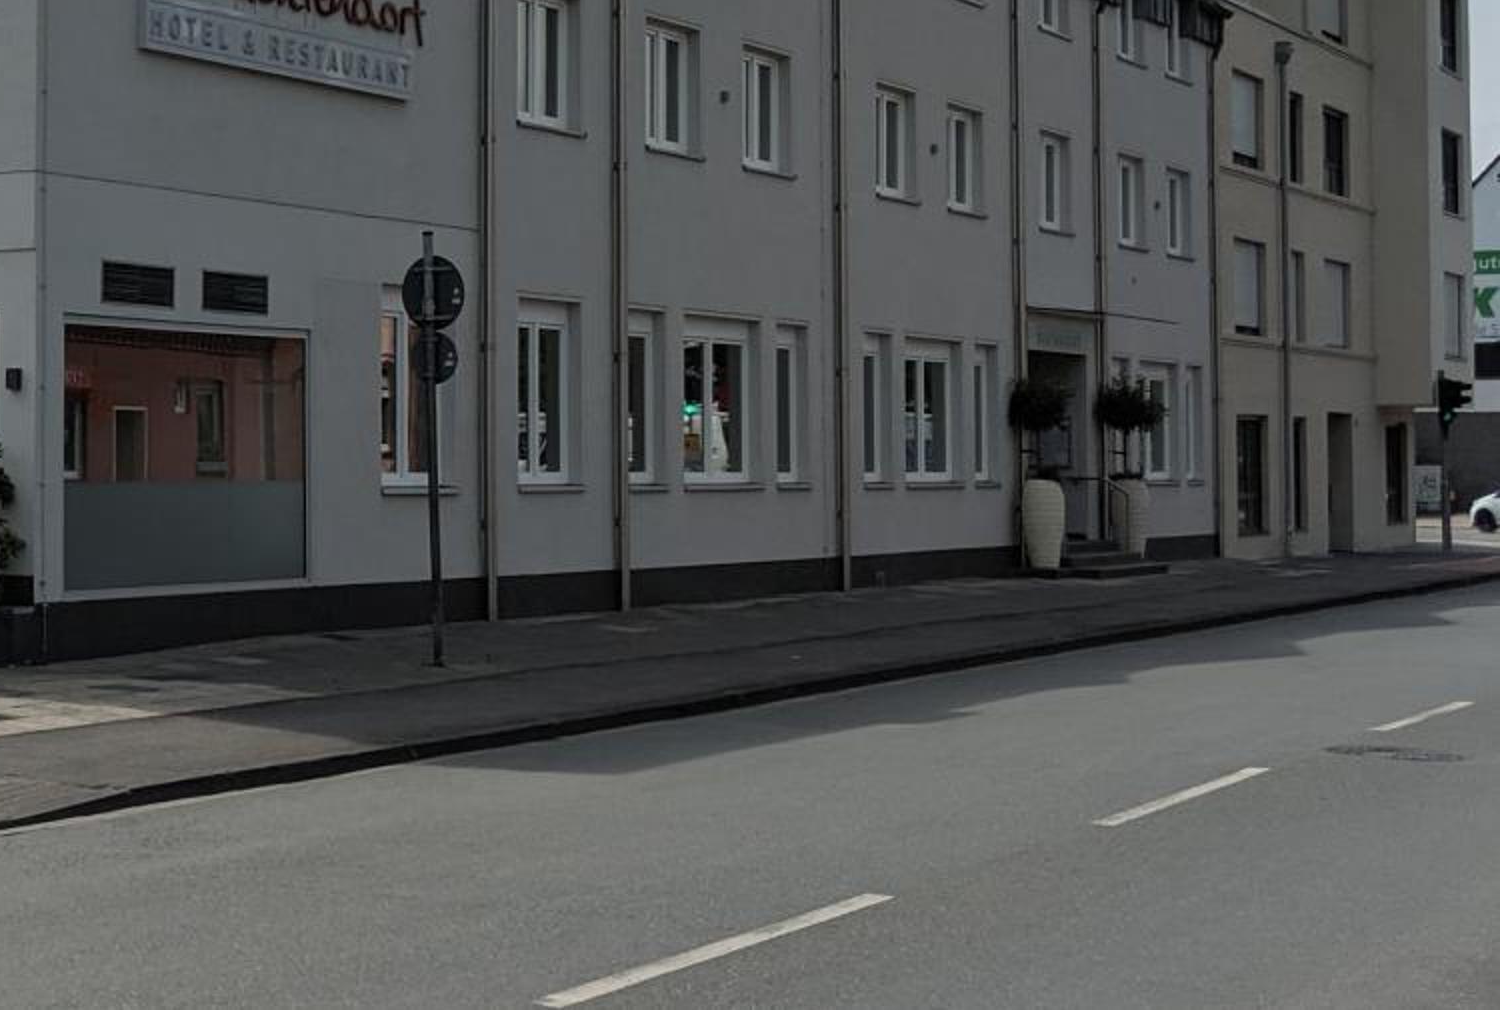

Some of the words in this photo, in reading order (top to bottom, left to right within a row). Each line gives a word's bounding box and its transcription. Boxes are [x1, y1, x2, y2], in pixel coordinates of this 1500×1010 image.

[149, 8, 228, 51] HOTEL
[243, 30, 256, 56] &
[267, 34, 411, 89] RESTAURANT
